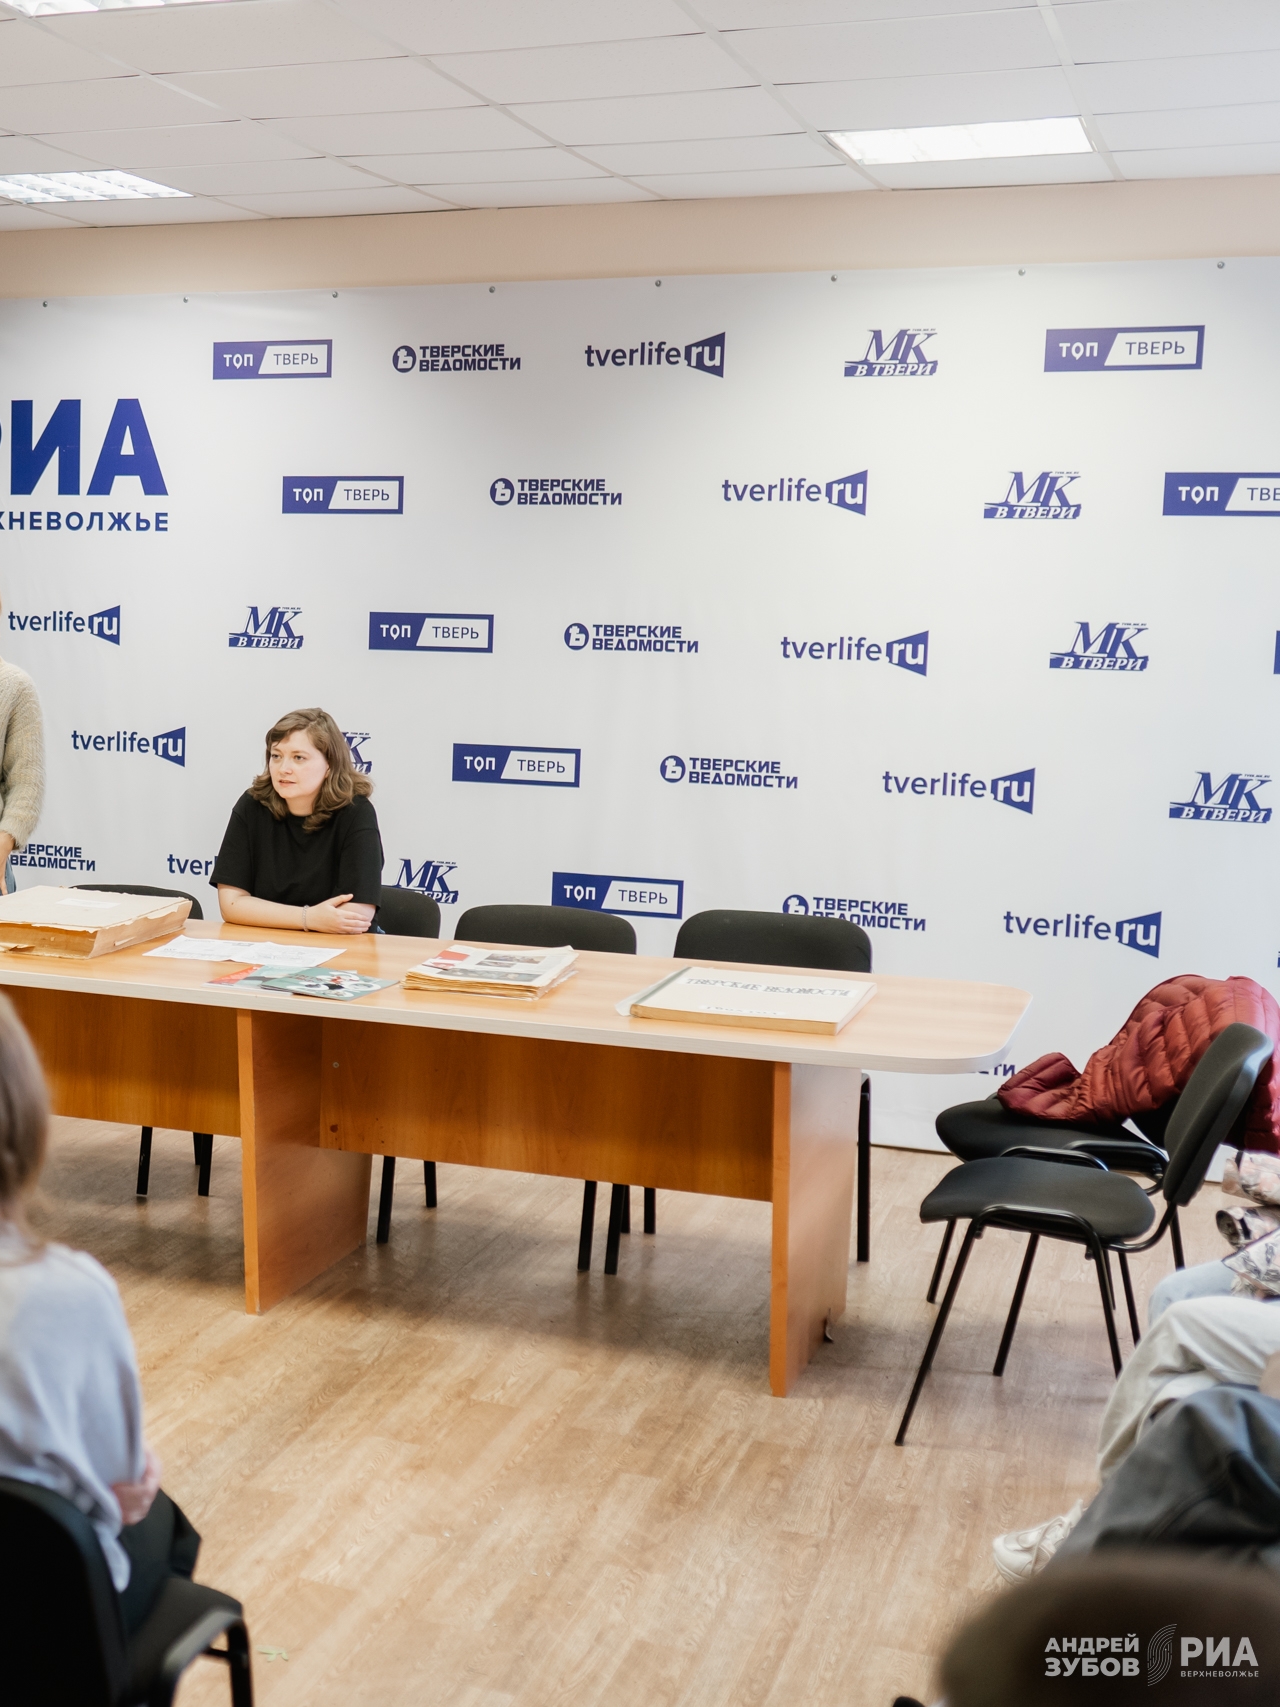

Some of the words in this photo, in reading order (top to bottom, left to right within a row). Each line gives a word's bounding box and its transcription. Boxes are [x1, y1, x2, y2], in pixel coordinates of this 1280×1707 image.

[420, 344, 505, 358] ТВЕРСКИЕ
[860, 329, 937, 364] МК
[1059, 342, 1097, 360] ТОП
[1126, 340, 1184, 357] ТВЕРЬ
[223, 353, 253, 368] ТОП
[274, 351, 318, 366] ТВЕРЬ
[419, 357, 521, 372] ВЕДОМОСТИ
[854, 364, 868, 376] В
[872, 364, 934, 376] ТВЕРИ
[518, 479, 605, 492] ТВЕРСКИЕ
[1000, 472, 1081, 506] МК
[293, 488, 323, 503] ТОП
[344, 487, 389, 502] ТВЕРЬ
[518, 492, 622, 505] ВЕДОМОСТИ
[1178, 486, 1219, 504] ТОП
[994, 506, 1008, 518] В
[1013, 507, 1077, 519] ТВЕРИ
[240, 606, 302, 638] МК
[380, 625, 410, 640] ТОП
[432, 626, 479, 640] ТВЕРЬ
[592, 624, 682, 640] ТВЕРСКИЕ
[1066, 621, 1148, 658] МК
[237, 637, 248, 647] В
[251, 637, 300, 648] ТВЕРИ
[592, 638, 698, 653] ВЕДОМОСТИ
[1060, 657, 1074, 668] В
[1079, 657, 1144, 670] ТВЕРИ
[464, 756, 495, 772] ТОП
[517, 759, 566, 773] ТВЕРЬ
[690, 757, 781, 774] ТВЕРСКИЕ
[689, 772, 798, 788] ВЕДОМОСТИ
[1186, 771, 1272, 809] МК
[1180, 807, 1195, 818] В
[1199, 808, 1267, 822] ТВЕРИ
[23, 844, 82, 858] ЕРСКИЕ
[10, 854, 96, 871] ВЕДОМОСТИ
[393, 858, 458, 892] МК
[564, 884, 596, 902] ТОП
[618, 889, 668, 905] ТВЕРЬ
[813, 897, 908, 915] ТВЕРСКИЕ
[686, 978, 762, 992] ТВЕРСКИЕ
[763, 986, 850, 996] ВЕДОМОСТИ
